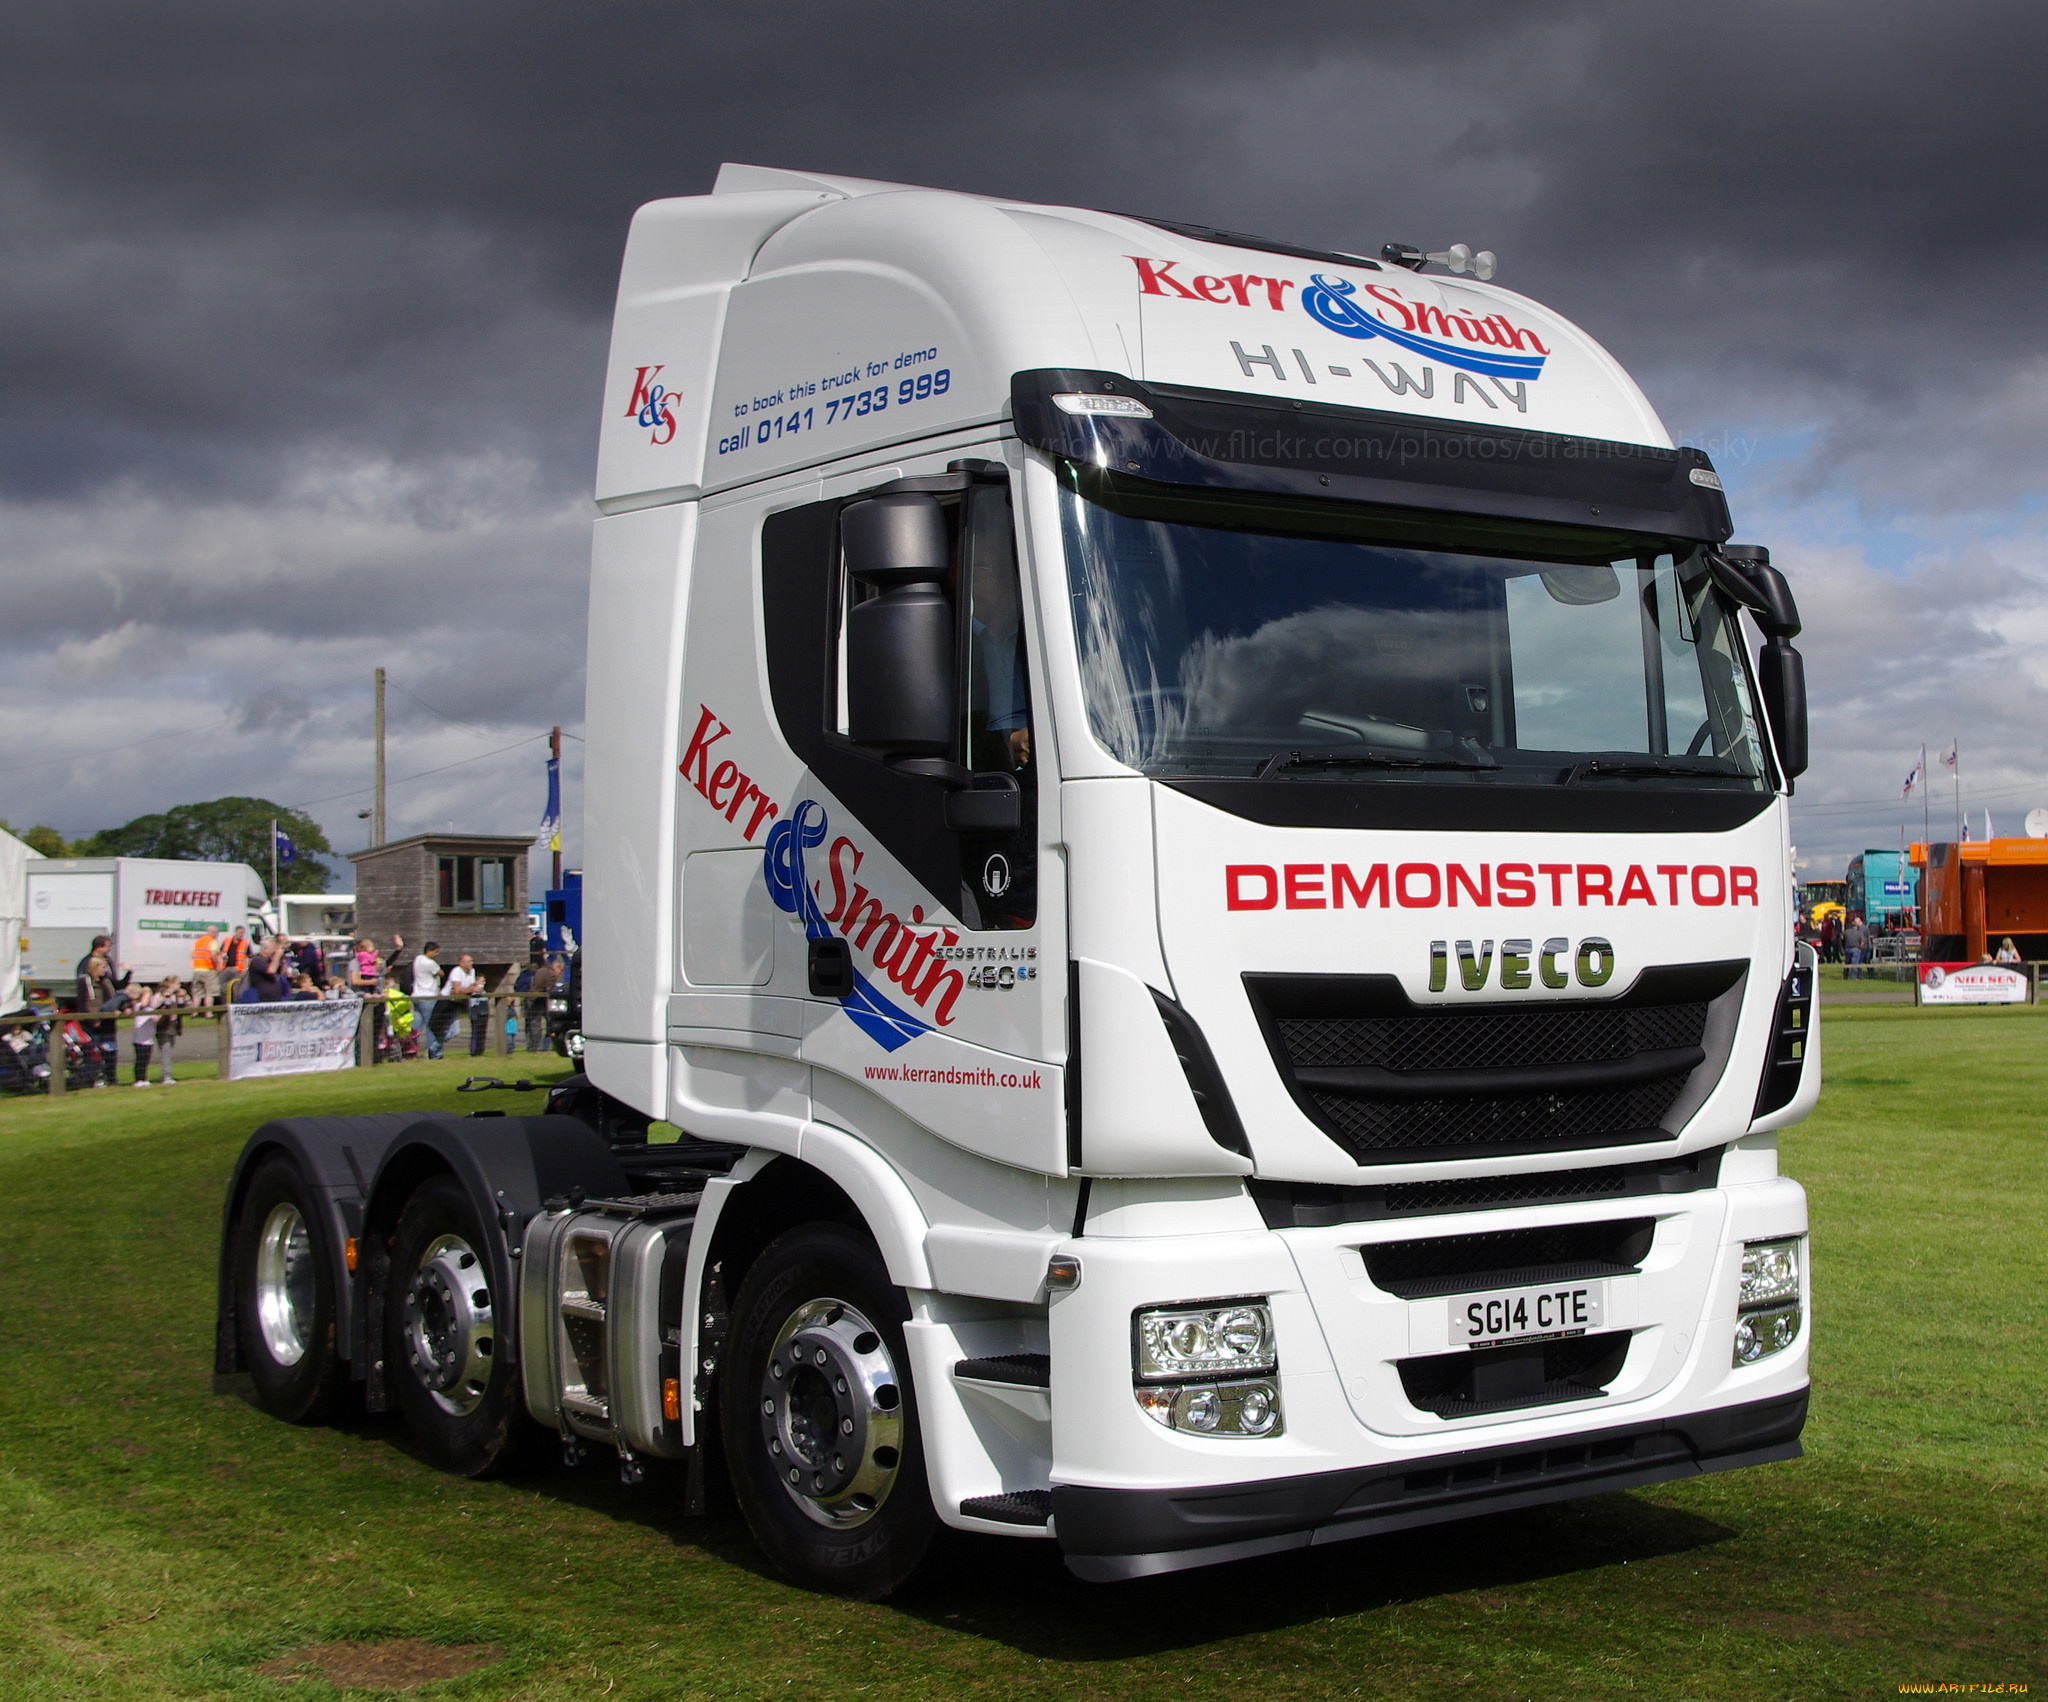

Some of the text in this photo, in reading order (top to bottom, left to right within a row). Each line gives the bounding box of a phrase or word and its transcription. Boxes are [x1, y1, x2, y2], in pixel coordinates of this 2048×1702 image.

[1123, 255, 1551, 356] Kerr & Smith
[734, 346, 938, 417] to book this truck for demo
[718, 368, 952, 455] call 0141 7733 999
[679, 703, 779, 842] Kerr
[814, 836, 965, 1027] Smith
[1225, 862, 1760, 912] DEMONSTRATOR
[146, 888, 223, 908] TRUCKFEST
[935, 946, 1037, 960] ECOSTRALIS
[1428, 936, 1615, 993] IVECO
[1954, 976, 2017, 984] NIELSEN
[864, 1064, 1042, 1089] www.kerrandsmith.co.uk
[1467, 1290, 1588, 1336] SG14 CTE
